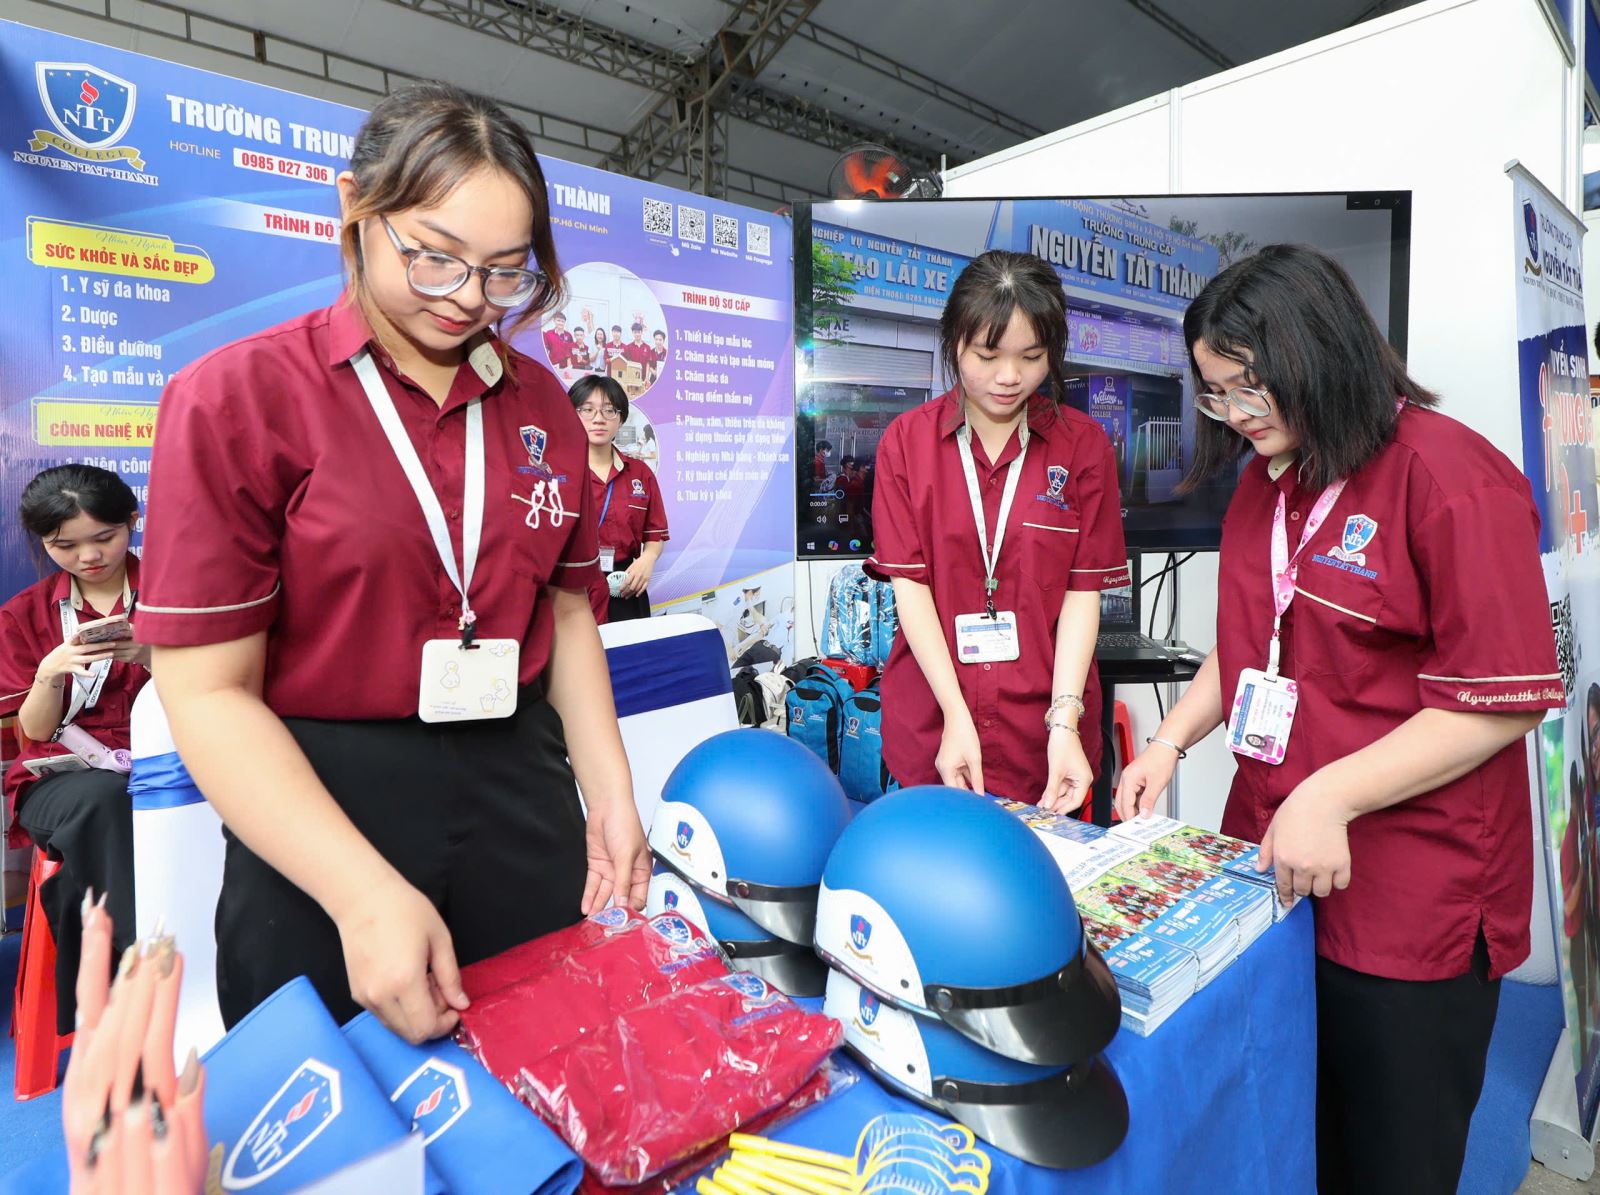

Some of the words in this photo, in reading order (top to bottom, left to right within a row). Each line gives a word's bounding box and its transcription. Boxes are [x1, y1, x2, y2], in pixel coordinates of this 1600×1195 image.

[63, 104, 114, 133] NTT
[166, 94, 282, 145] TRƯỜNG
[289, 122, 355, 160] TRUN
[14, 151, 78, 172] NGUYEN
[79, 163, 109, 177] TAT
[111, 168, 159, 186] THANH
[170, 140, 221, 160] HOTLINE
[241, 152, 274, 171] 0985
[278, 161, 301, 177] 027
[305, 166, 328, 182] 306
[554, 183, 611, 216] THÀNH
[264, 213, 310, 235] TRÌNH
[314, 219, 335, 241] ĐỘ
[589, 223, 609, 234] Minh
[1031, 223, 1117, 280] NGUYỄN
[1125, 250, 1155, 288] TẤT
[1128, 232, 1157, 251] TRUNG
[45, 242, 75, 260] SỨC
[80, 246, 117, 266] KHỎE
[121, 252, 139, 268] VÀ
[143, 253, 170, 272] SẮC
[173, 260, 199, 277] ĐẸP
[61, 275, 75, 292] 1.
[79, 276, 89, 293] Y
[93, 279, 110, 298] sỹ
[114, 281, 132, 298] đa
[136, 283, 170, 302] khoa
[885, 259, 918, 287] LÁI
[923, 268, 948, 292] XE
[682, 290, 707, 306] TRÌNH
[709, 295, 720, 310] ĐỘ
[61, 304, 75, 322] 2.
[80, 306, 118, 328] Dược
[62, 335, 76, 352] 3.
[80, 335, 114, 355] Điều
[118, 339, 162, 360] dưỡng
[63, 364, 77, 382] 4.
[81, 365, 108, 387] Tạo
[112, 365, 144, 386] mẫu
[148, 370, 164, 386] và
[50, 420, 90, 437] CÔNG
[94, 422, 132, 441] NGHỆ
[136, 425, 153, 438] KỸ
